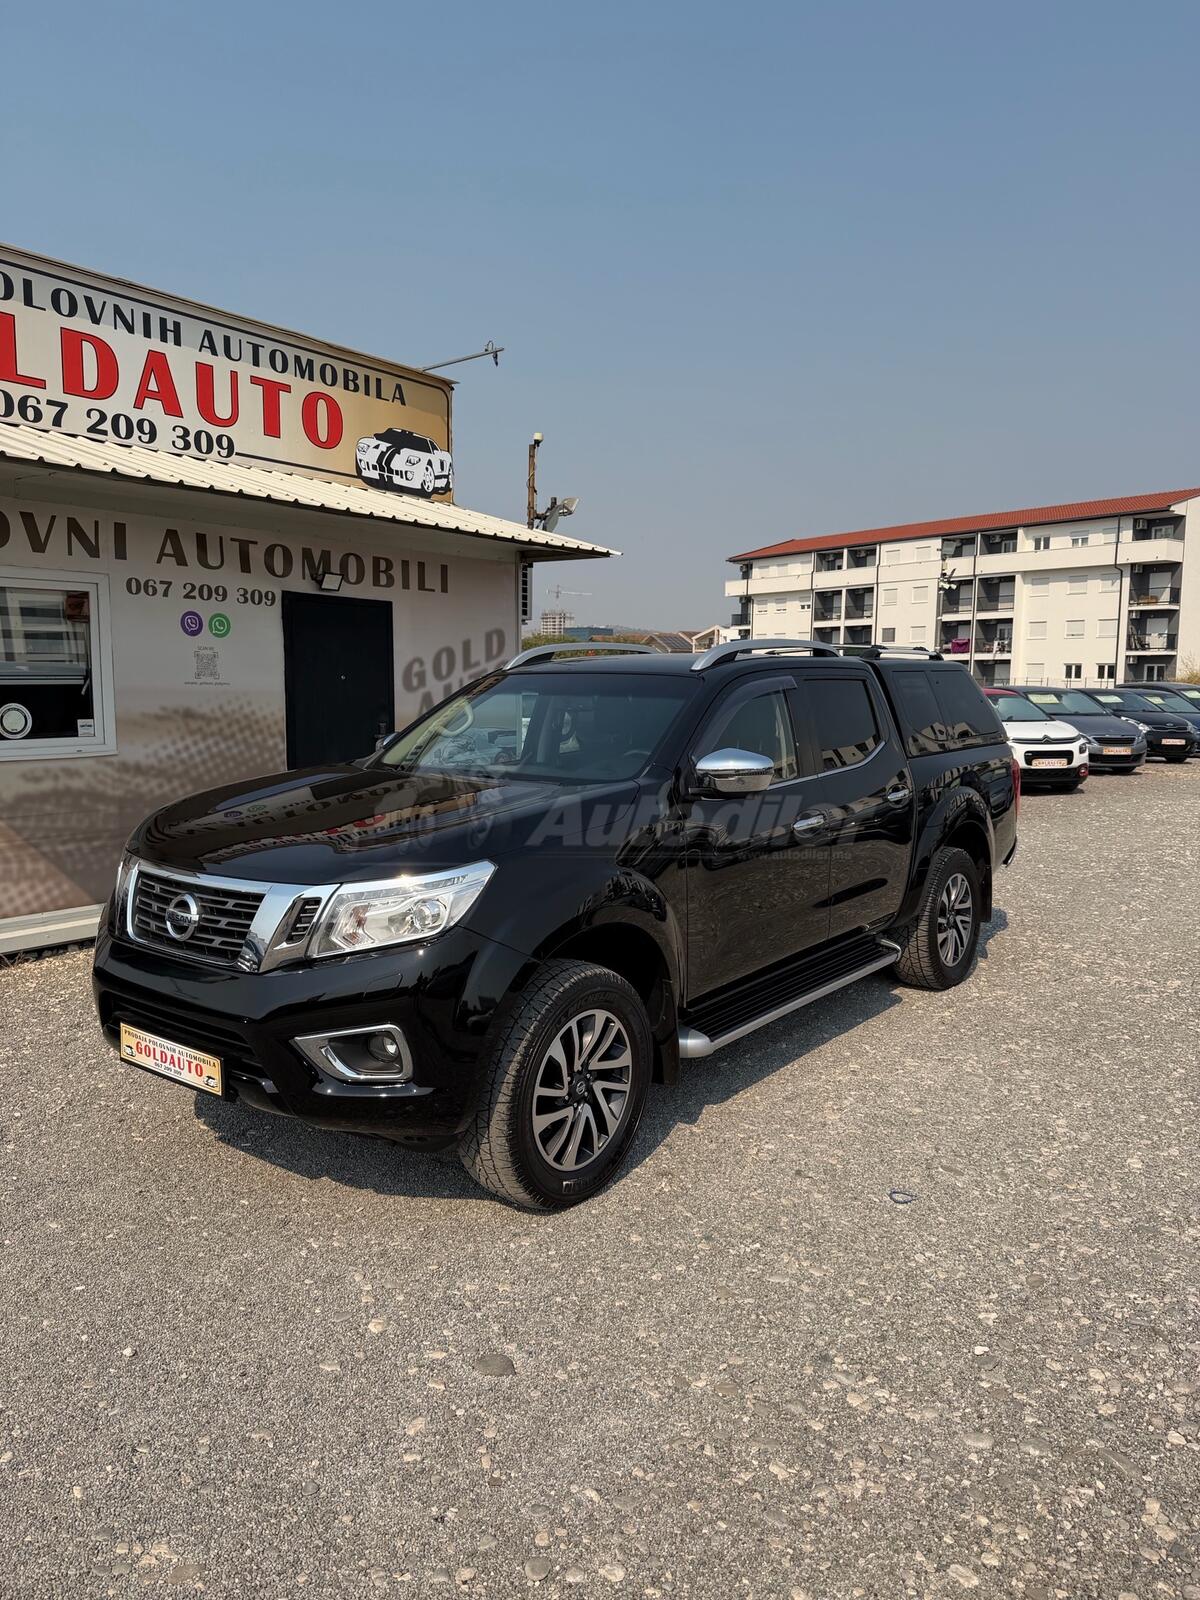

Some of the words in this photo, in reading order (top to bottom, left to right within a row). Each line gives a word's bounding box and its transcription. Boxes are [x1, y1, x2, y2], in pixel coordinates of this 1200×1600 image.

[0, 311, 344, 450] LDAUTO
[198, 329, 407, 406] AUTOMOBILA
[0, 390, 69, 428] 067
[86, 408, 158, 445] 209
[171, 425, 235, 459] 309
[126, 577, 173, 598] 067
[183, 581, 228, 602] 209
[236, 587, 276, 607] 309
[156, 528, 449, 593] AUTOMOBILI
[402, 628, 506, 693] GOLD
[135, 1041, 204, 1077] GOLDAUTO
[178, 1049, 217, 1068] AUTOMOBILA
